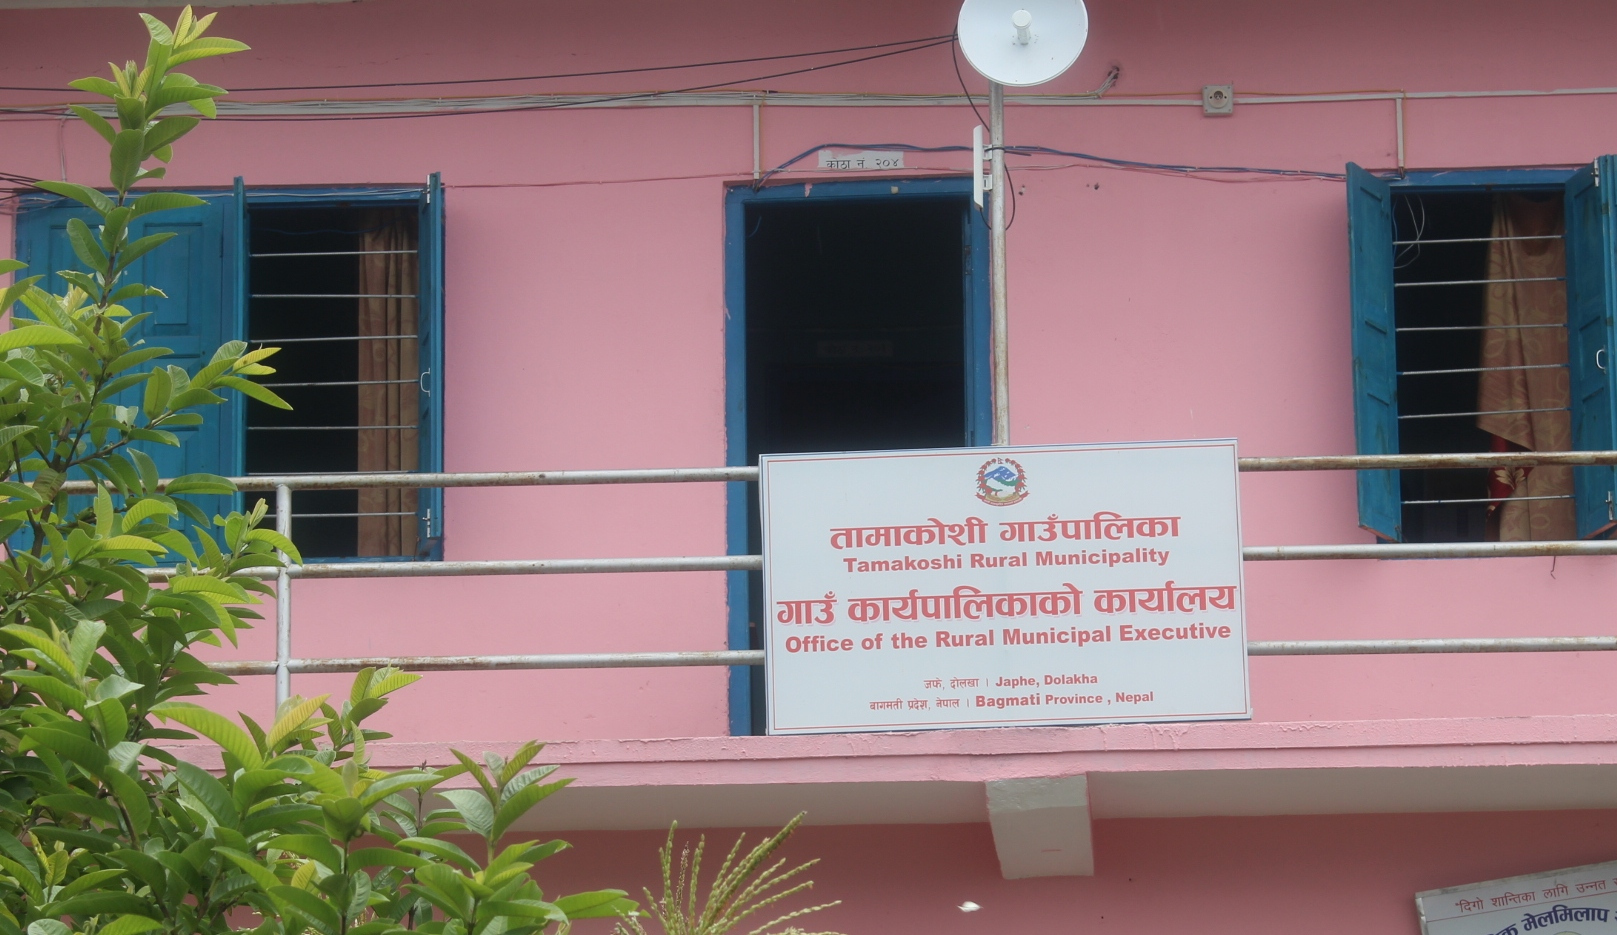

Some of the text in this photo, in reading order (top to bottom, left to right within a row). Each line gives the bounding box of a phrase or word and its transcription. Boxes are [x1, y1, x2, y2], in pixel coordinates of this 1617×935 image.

[875, 158, 900, 169] २०४
[830, 511, 1181, 550] तामाकोशी गाउँपालिका
[843, 548, 1170, 573] Tamakoshi Rural Municipality
[776, 580, 1238, 625] गाउँ कार्यपालिकाको कार्यालय
[785, 622, 1232, 654] Office of the Rural Municipal Executive
[950, 676, 980, 689] दोलखा
[995, 675, 1040, 689] Japhe,
[1044, 673, 1099, 686] Dolakha
[869, 697, 903, 711] बागमती
[936, 696, 961, 708] नेपाल
[975, 692, 1041, 710] Bagmati
[1045, 693, 1103, 705] Province
[1115, 691, 1154, 705] Nepal
[1490, 891, 1536, 907] शान्तिका
[1542, 883, 1569, 899] लागि
[1575, 880, 1607, 893] उन्नत
[1520, 904, 1610, 931] मेलमिलाप
